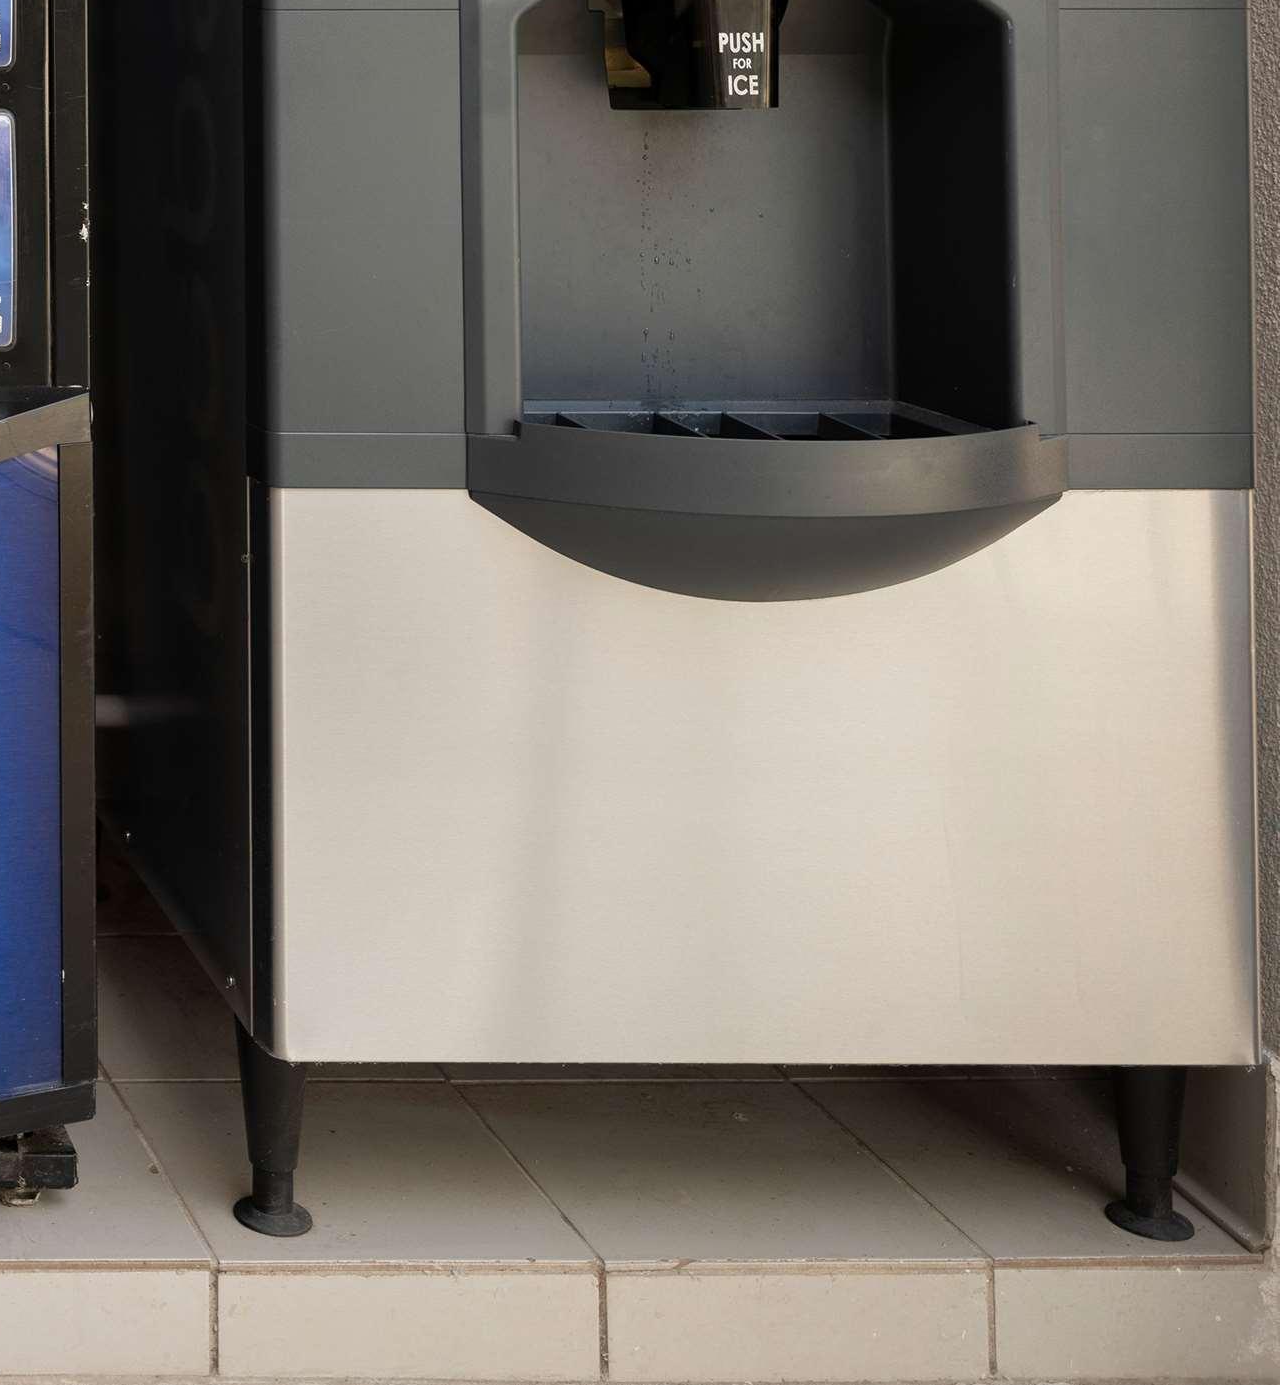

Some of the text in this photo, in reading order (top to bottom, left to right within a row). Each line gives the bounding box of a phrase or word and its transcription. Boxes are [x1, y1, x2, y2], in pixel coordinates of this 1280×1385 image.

[718, 32, 764, 54] PUSH
[732, 58, 752, 70] FOR
[728, 74, 759, 96] ICE
